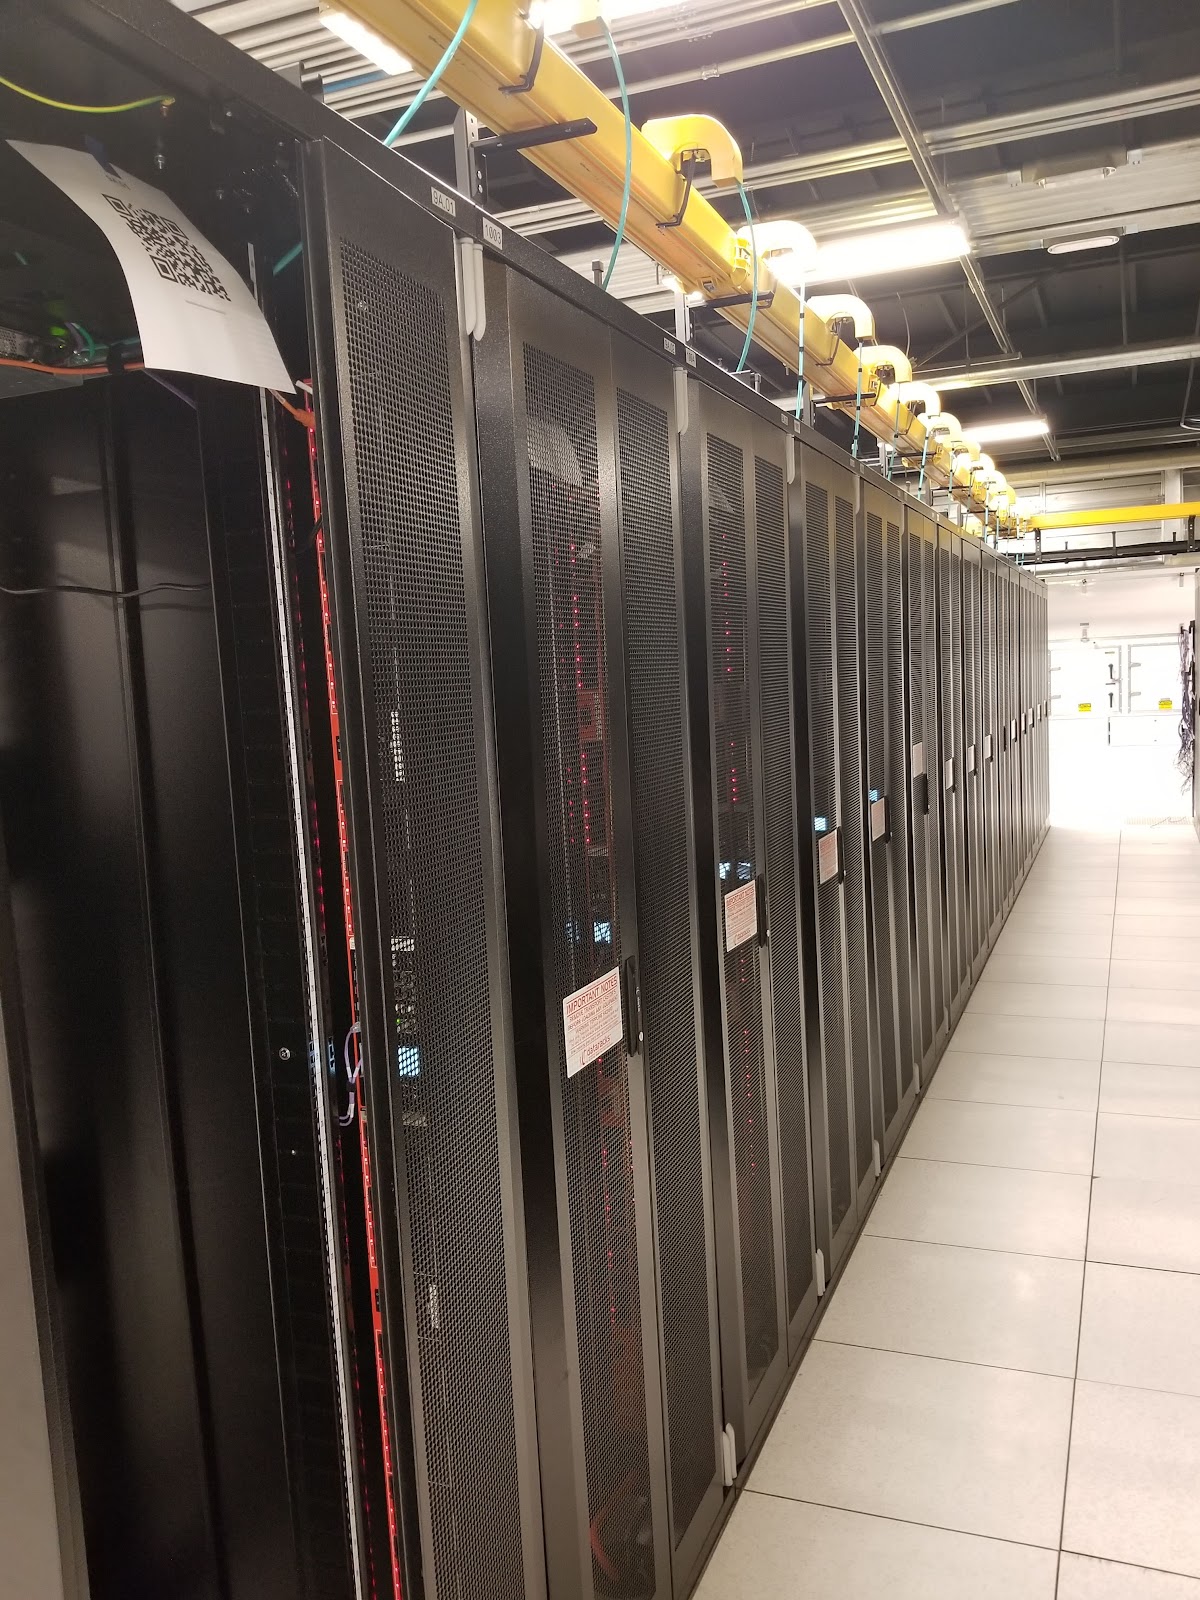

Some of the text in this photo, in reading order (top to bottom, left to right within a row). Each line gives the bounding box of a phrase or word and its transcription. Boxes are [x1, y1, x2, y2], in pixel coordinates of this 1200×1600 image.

[433, 191, 454, 215] 9A.01
[566, 989, 600, 1015] IMPORTANT
[600, 978, 617, 995] NOTES
[586, 1035, 611, 1056] dataracks
